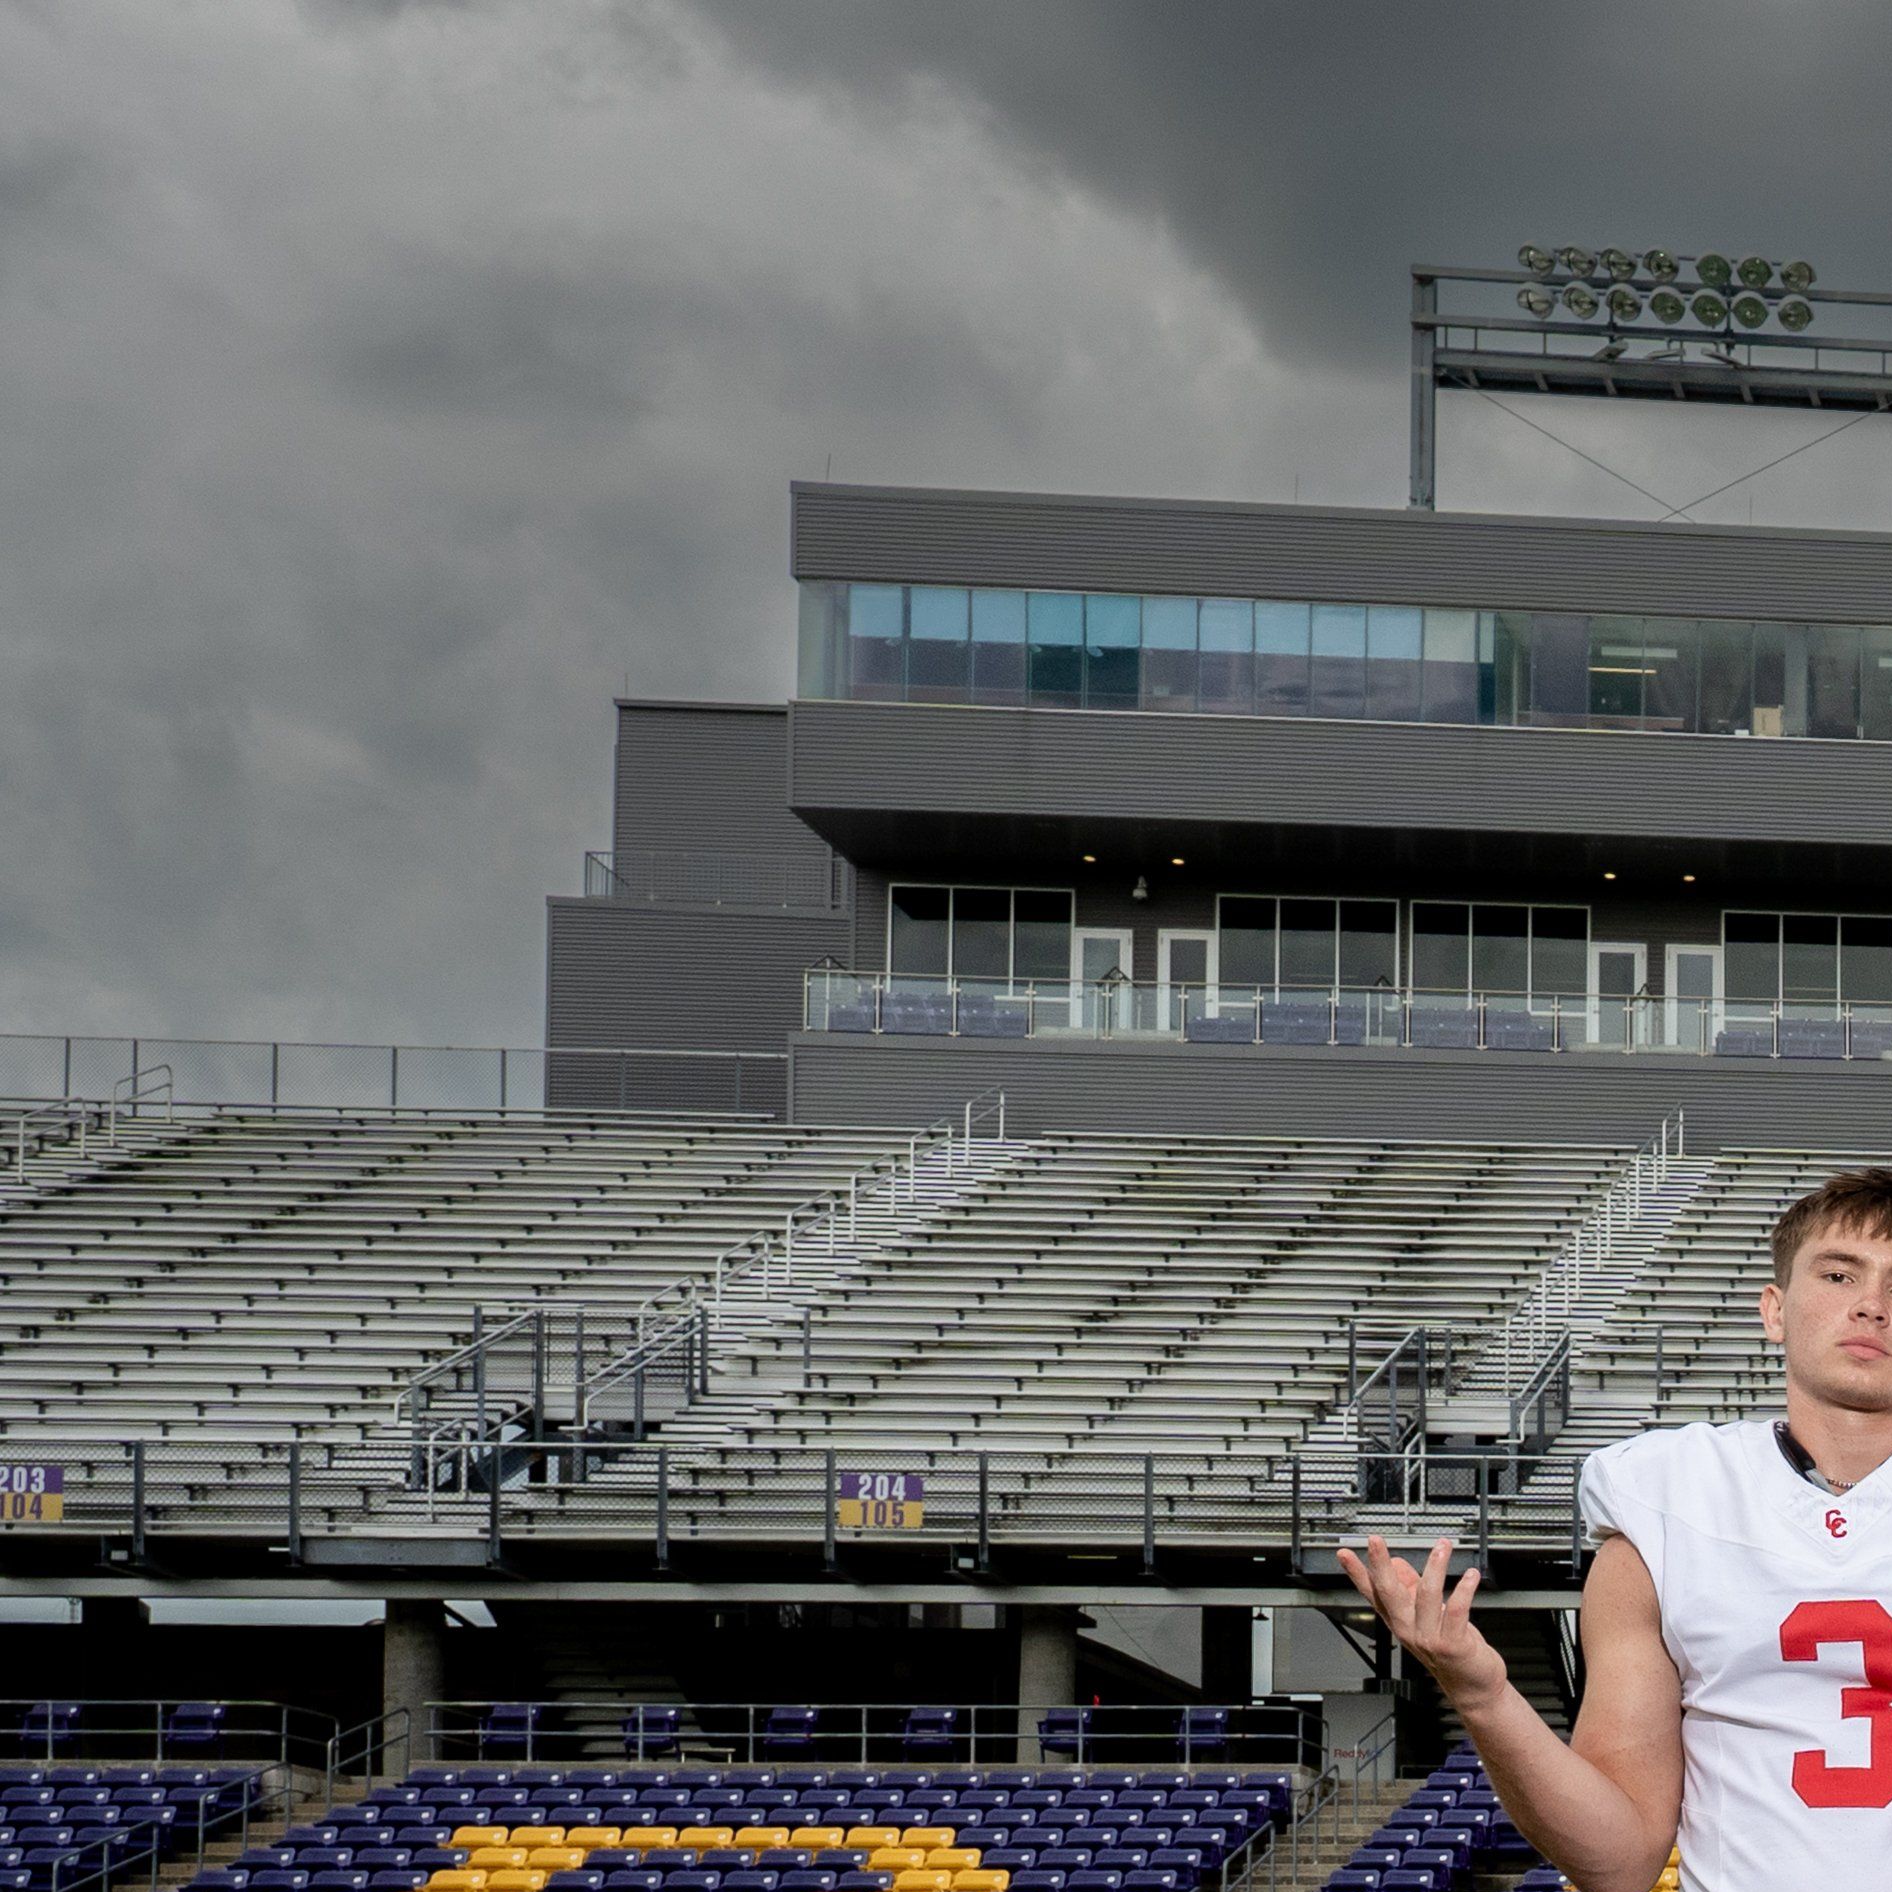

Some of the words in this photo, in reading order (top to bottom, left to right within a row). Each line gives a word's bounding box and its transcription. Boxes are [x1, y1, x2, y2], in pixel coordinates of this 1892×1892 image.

[0, 1466, 46, 1493] 203
[858, 1473, 906, 1501] 204
[861, 1501, 904, 1526] 105
[1825, 1509, 1847, 1538] CC
